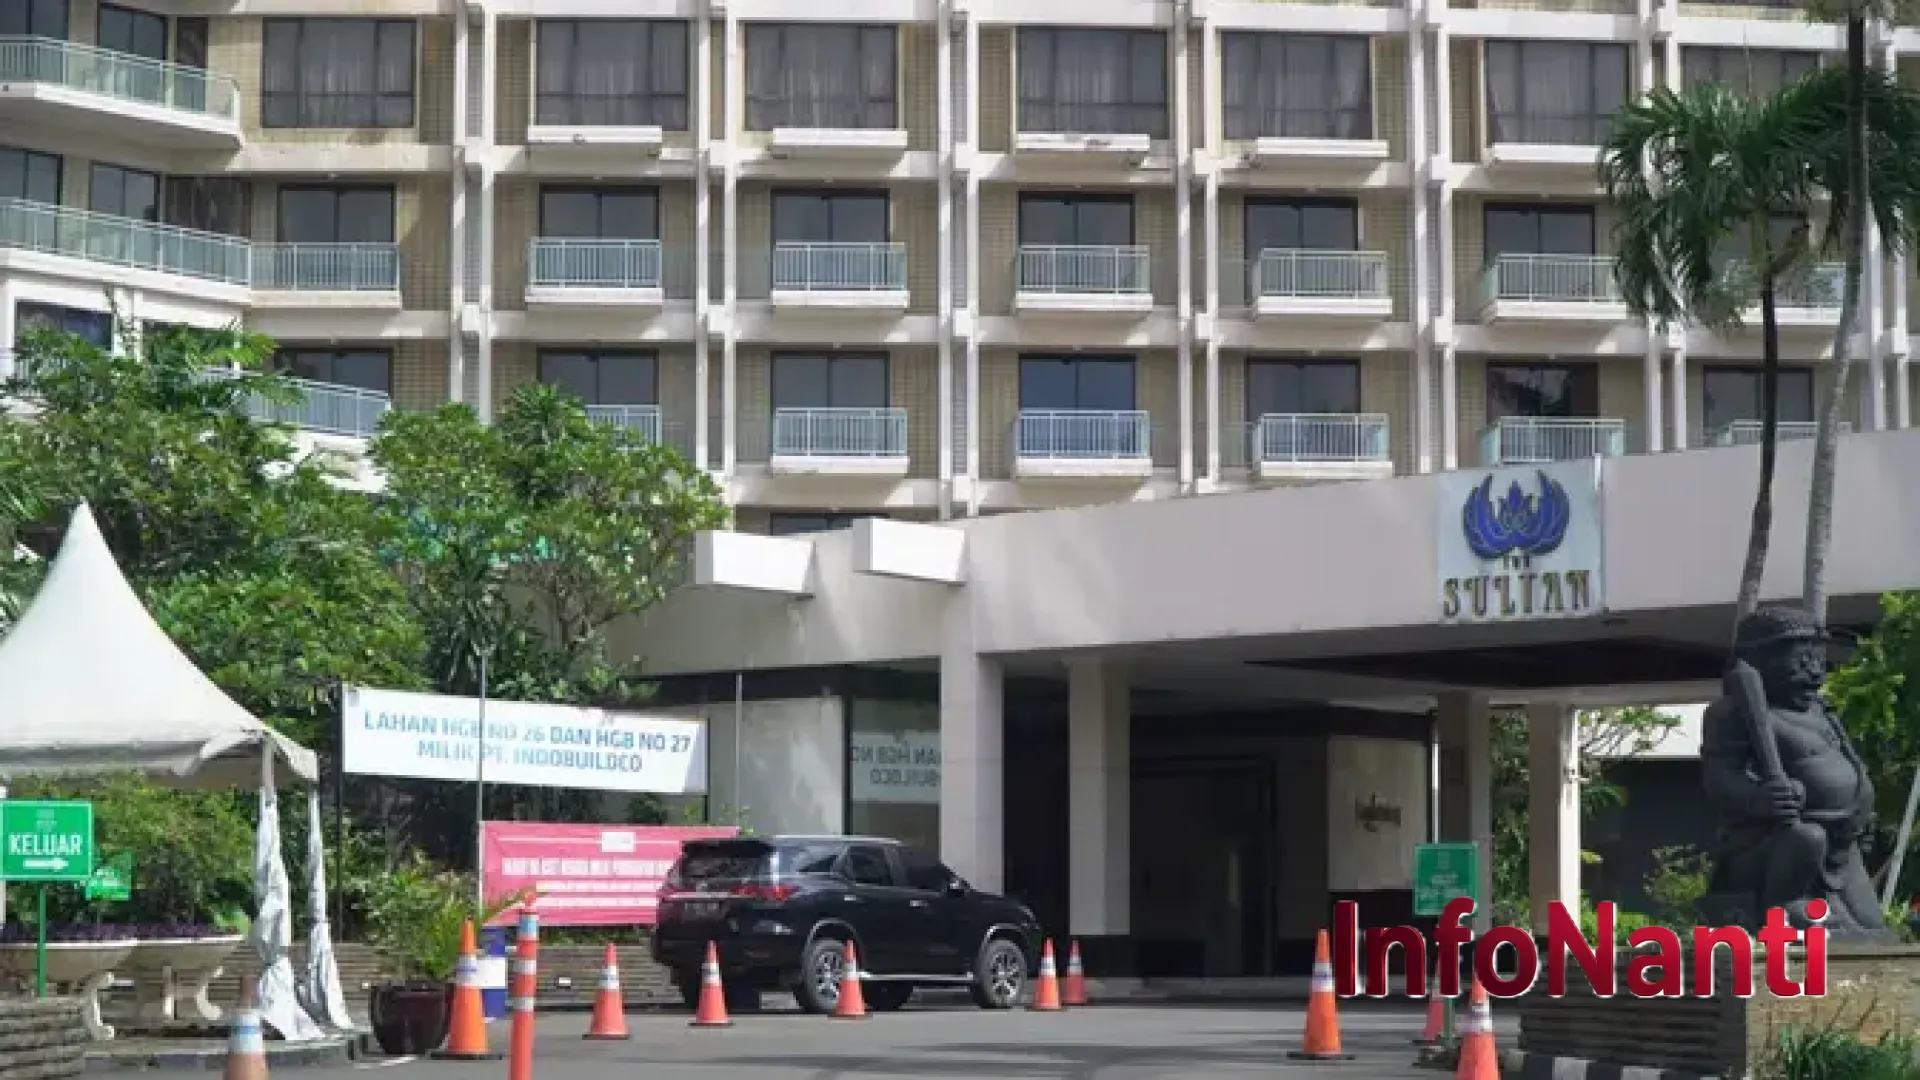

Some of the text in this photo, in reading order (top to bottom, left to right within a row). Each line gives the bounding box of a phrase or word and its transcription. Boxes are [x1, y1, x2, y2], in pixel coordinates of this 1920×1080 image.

[1443, 569, 1590, 617] SULTAN
[364, 710, 438, 734] LAHAN
[550, 726, 591, 745] DAN
[595, 729, 634, 749] HGB
[638, 732, 666, 751] NO
[670, 734, 692, 753] 27
[8, 832, 82, 856] KELUAR
